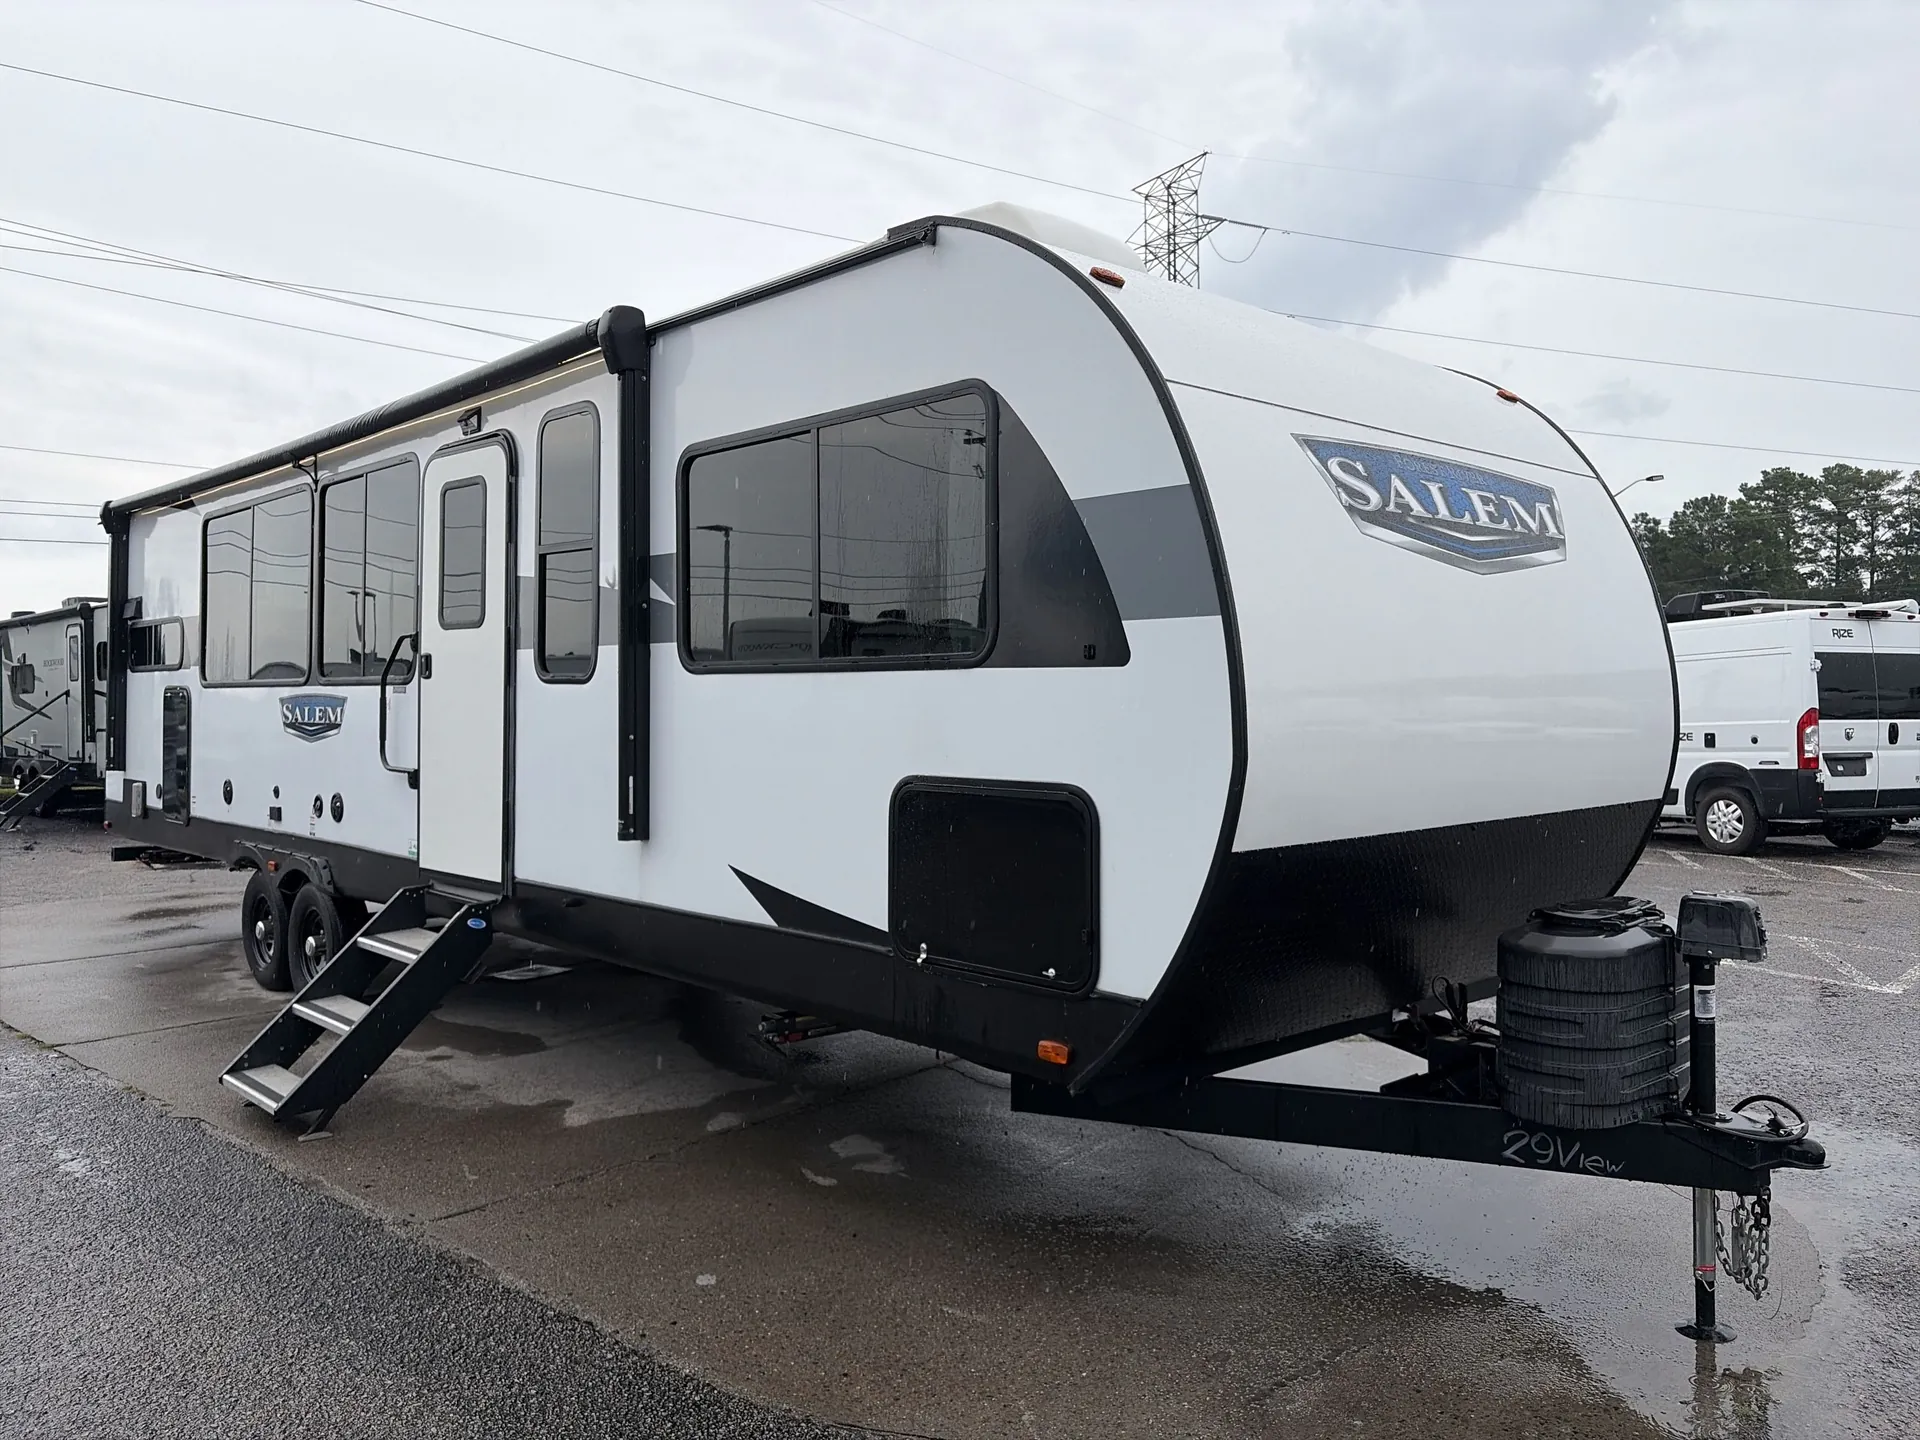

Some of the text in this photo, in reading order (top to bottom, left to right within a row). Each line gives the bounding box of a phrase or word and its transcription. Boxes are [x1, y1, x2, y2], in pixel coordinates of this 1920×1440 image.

[1327, 457, 1565, 539] SALEM
[1832, 628, 1854, 639] RIZE
[283, 703, 342, 724] SALEM
[1679, 732, 1693, 741] ZE
